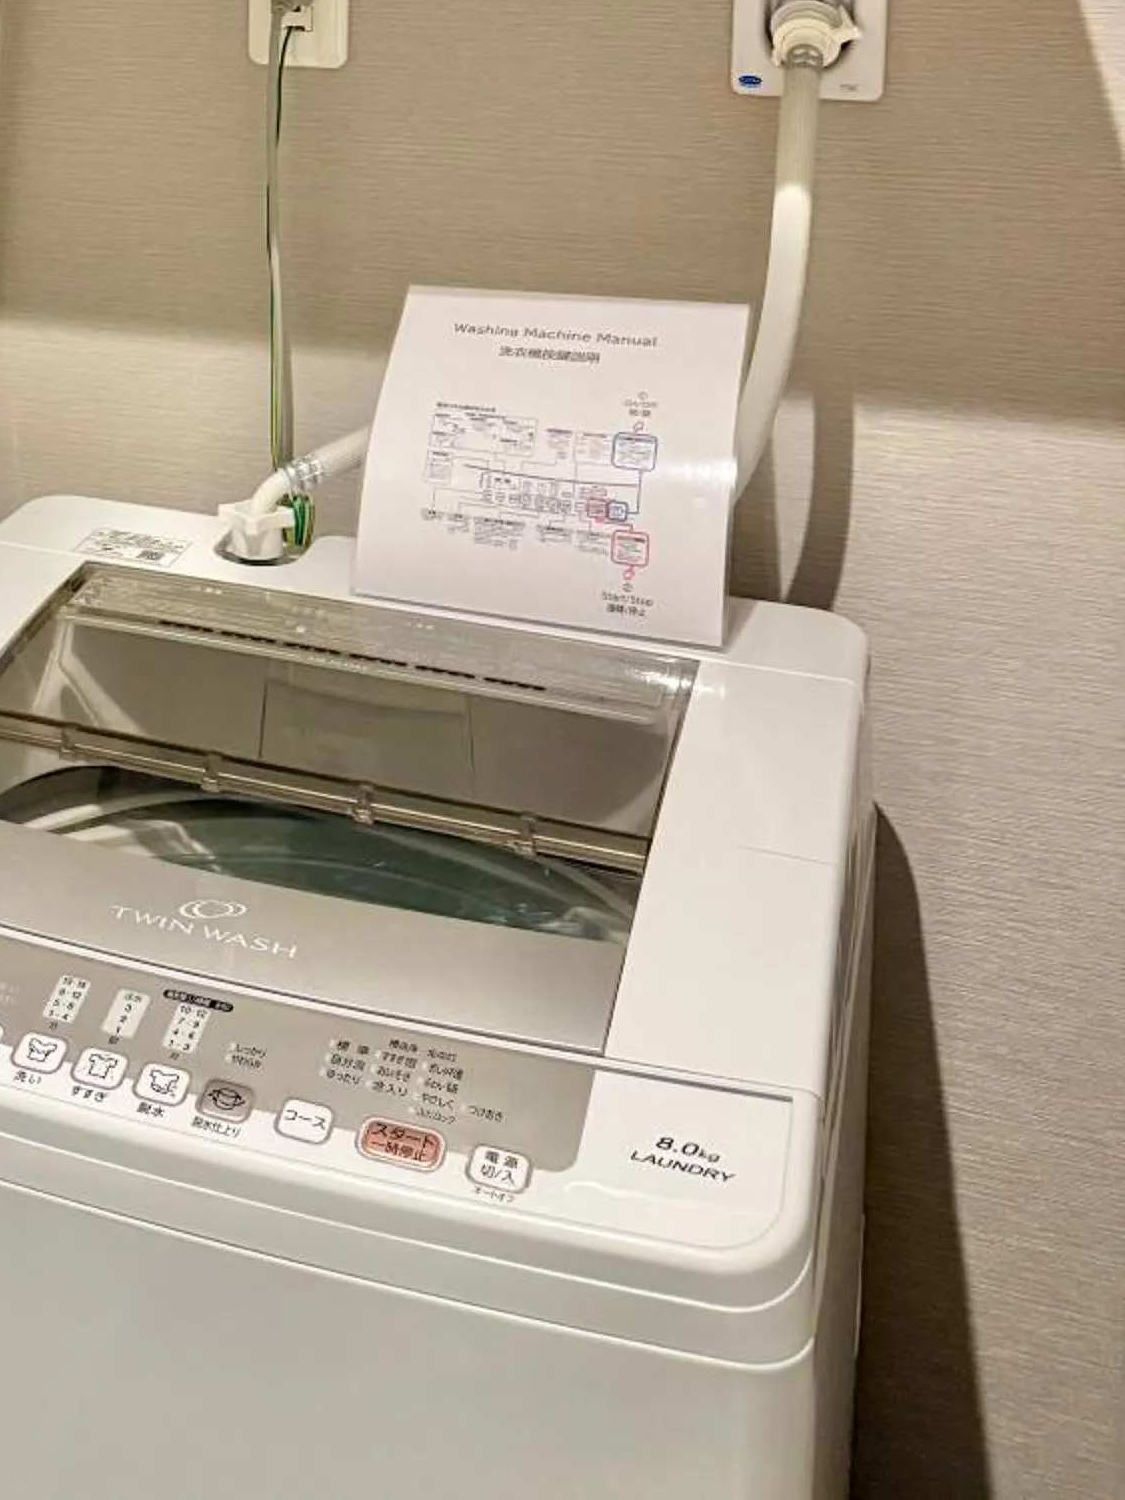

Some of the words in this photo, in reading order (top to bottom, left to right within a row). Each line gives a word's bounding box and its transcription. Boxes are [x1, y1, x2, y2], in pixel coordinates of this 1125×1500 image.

[454, 323, 519, 337] Washing
[525, 327, 591, 343] Machine
[596, 333, 658, 347] Manual
[110, 904, 194, 935] TWIN
[203, 925, 297, 958] WASH
[72, 1086, 107, 1102] すすぎ
[137, 1102, 166, 1118] 脱水
[284, 1108, 327, 1130] コース
[372, 1122, 435, 1148] スタート
[371, 1141, 426, 1162] 一時停止
[485, 1150, 519, 1169] 電源
[656, 1137, 721, 1163] 8.0kg
[630, 1150, 736, 1182] LAUNDRY
